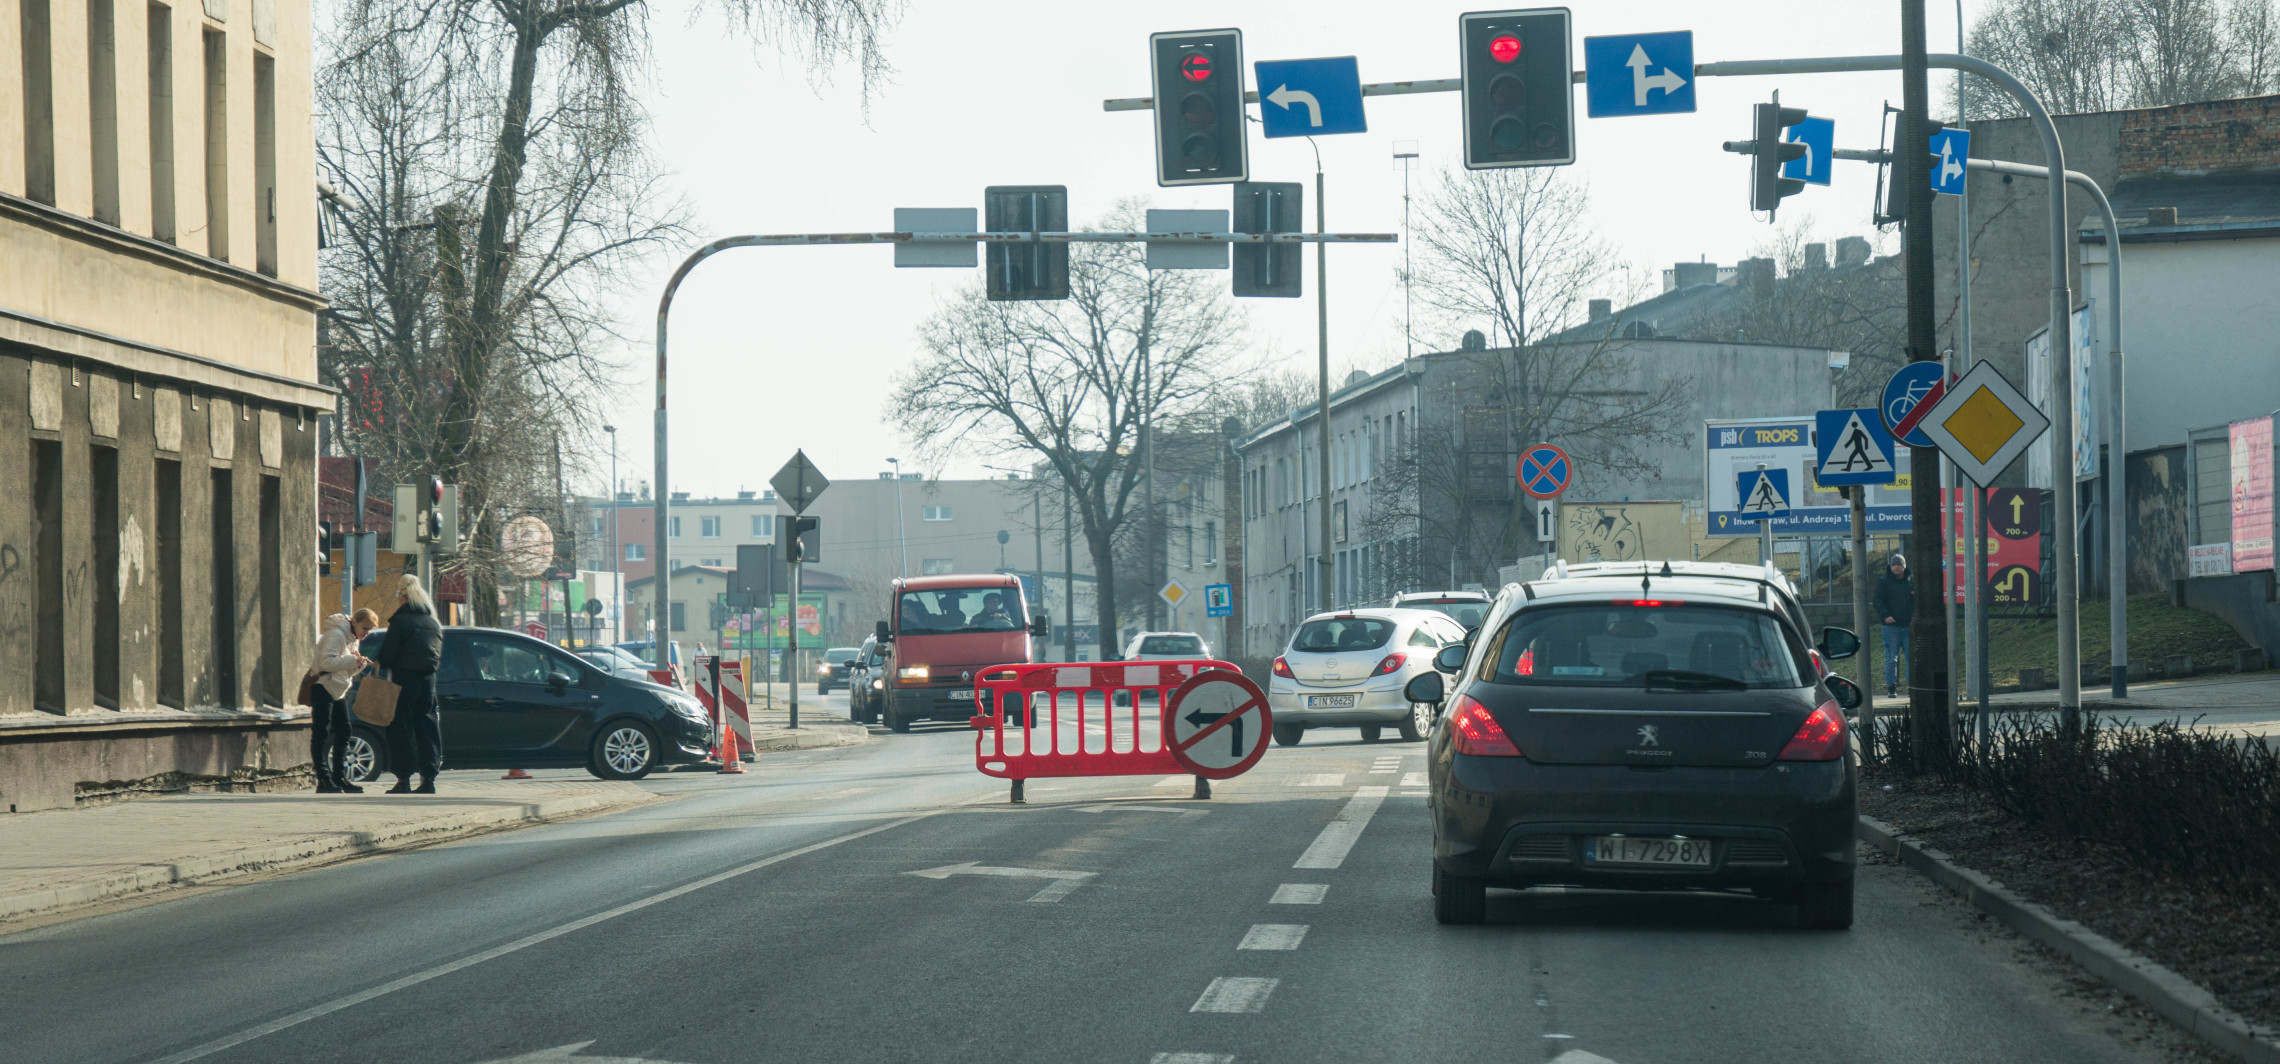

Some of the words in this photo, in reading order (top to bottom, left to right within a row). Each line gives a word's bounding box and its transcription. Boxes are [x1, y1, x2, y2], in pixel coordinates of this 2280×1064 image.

[1721, 428, 1737, 447] psb
[1755, 429, 1799, 444] TROPS
[1790, 515, 1801, 524] ul.
[1803, 514, 1842, 525] Andrzeja
[1866, 513, 1876, 522] ul.
[1313, 697, 1328, 706] CIN
[1330, 696, 1353, 706] 96625
[1626, 749, 1673, 757] PEUGEOT
[1745, 750, 1767, 759] 308
[1600, 838, 1627, 860] WI
[1639, 840, 1707, 863] 7298X
